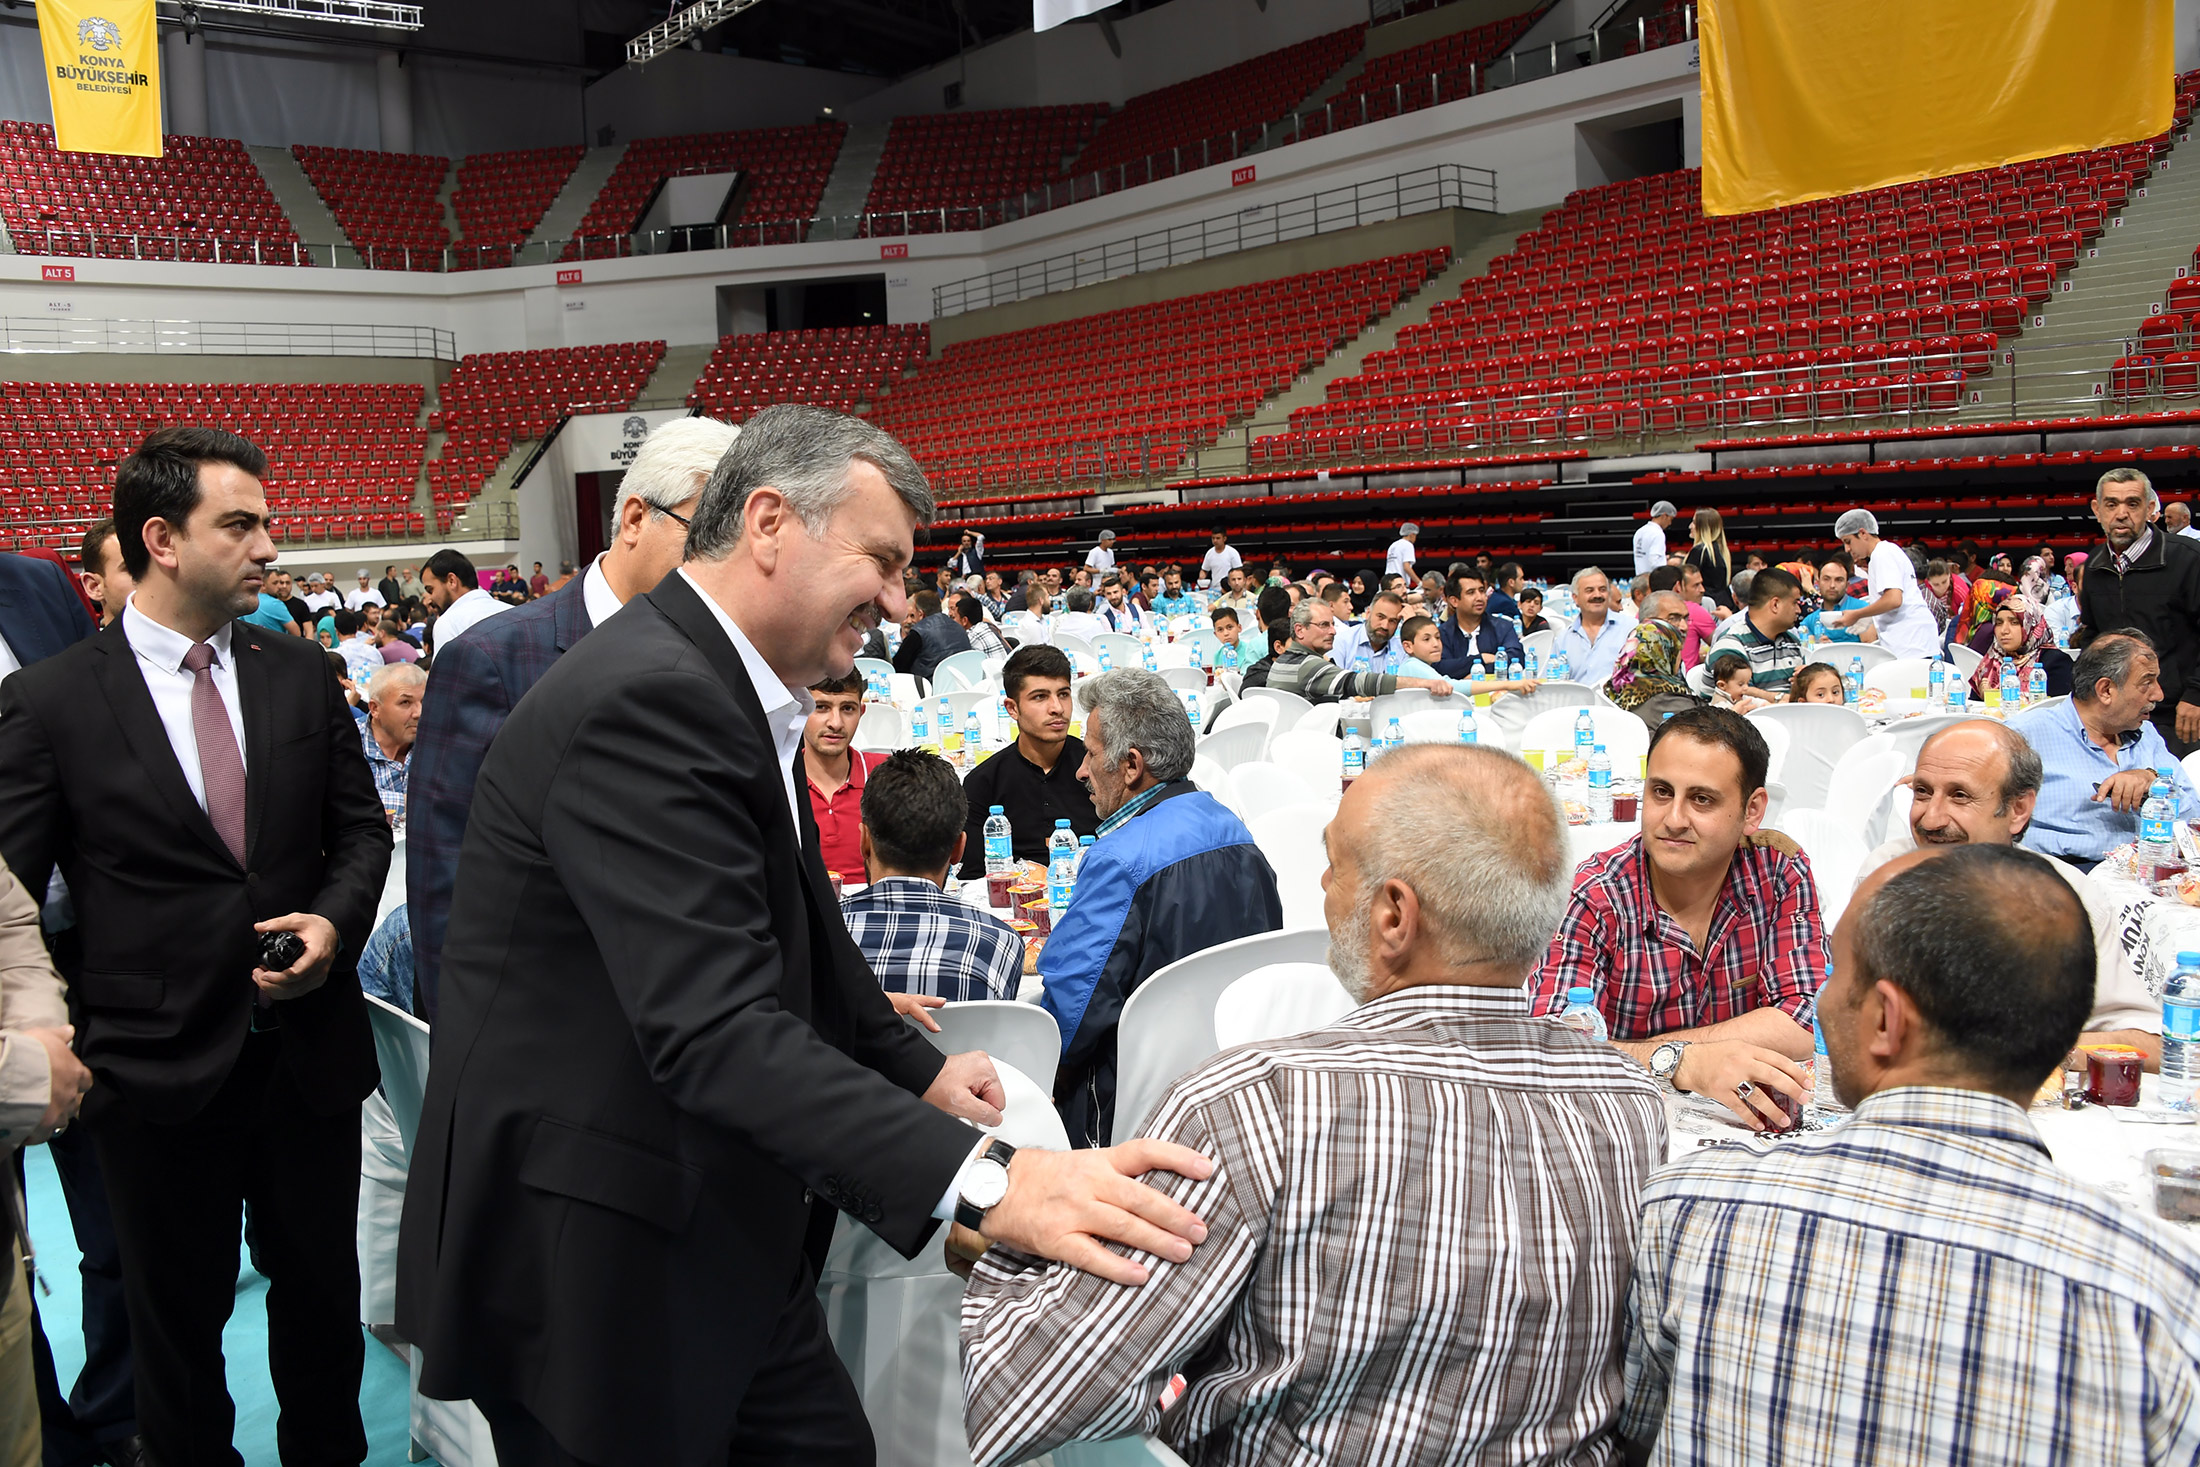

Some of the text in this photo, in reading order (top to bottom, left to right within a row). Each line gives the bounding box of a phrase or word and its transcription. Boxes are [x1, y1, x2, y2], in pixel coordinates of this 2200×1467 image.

[79, 54, 125, 69] KONYA
[56, 64, 148, 87] BÜYÜKŞEHİR
[76, 83, 132, 95] BELEDİYESİ
[2161, 161, 2168, 170] H
[1234, 170, 1247, 183] ALT
[2138, 189, 2145, 198] G
[884, 247, 898, 257] ALT
[45, 268, 72, 279] ALT 5
[559, 272, 573, 282] ALT
[2178, 267, 2185, 277] D
[2063, 282, 2070, 292] D
[2152, 303, 2159, 314] C
[2035, 316, 2042, 327] C
[2006, 353, 2013, 364] B
[2094, 383, 2103, 395] A
[1972, 392, 1980, 403] A
